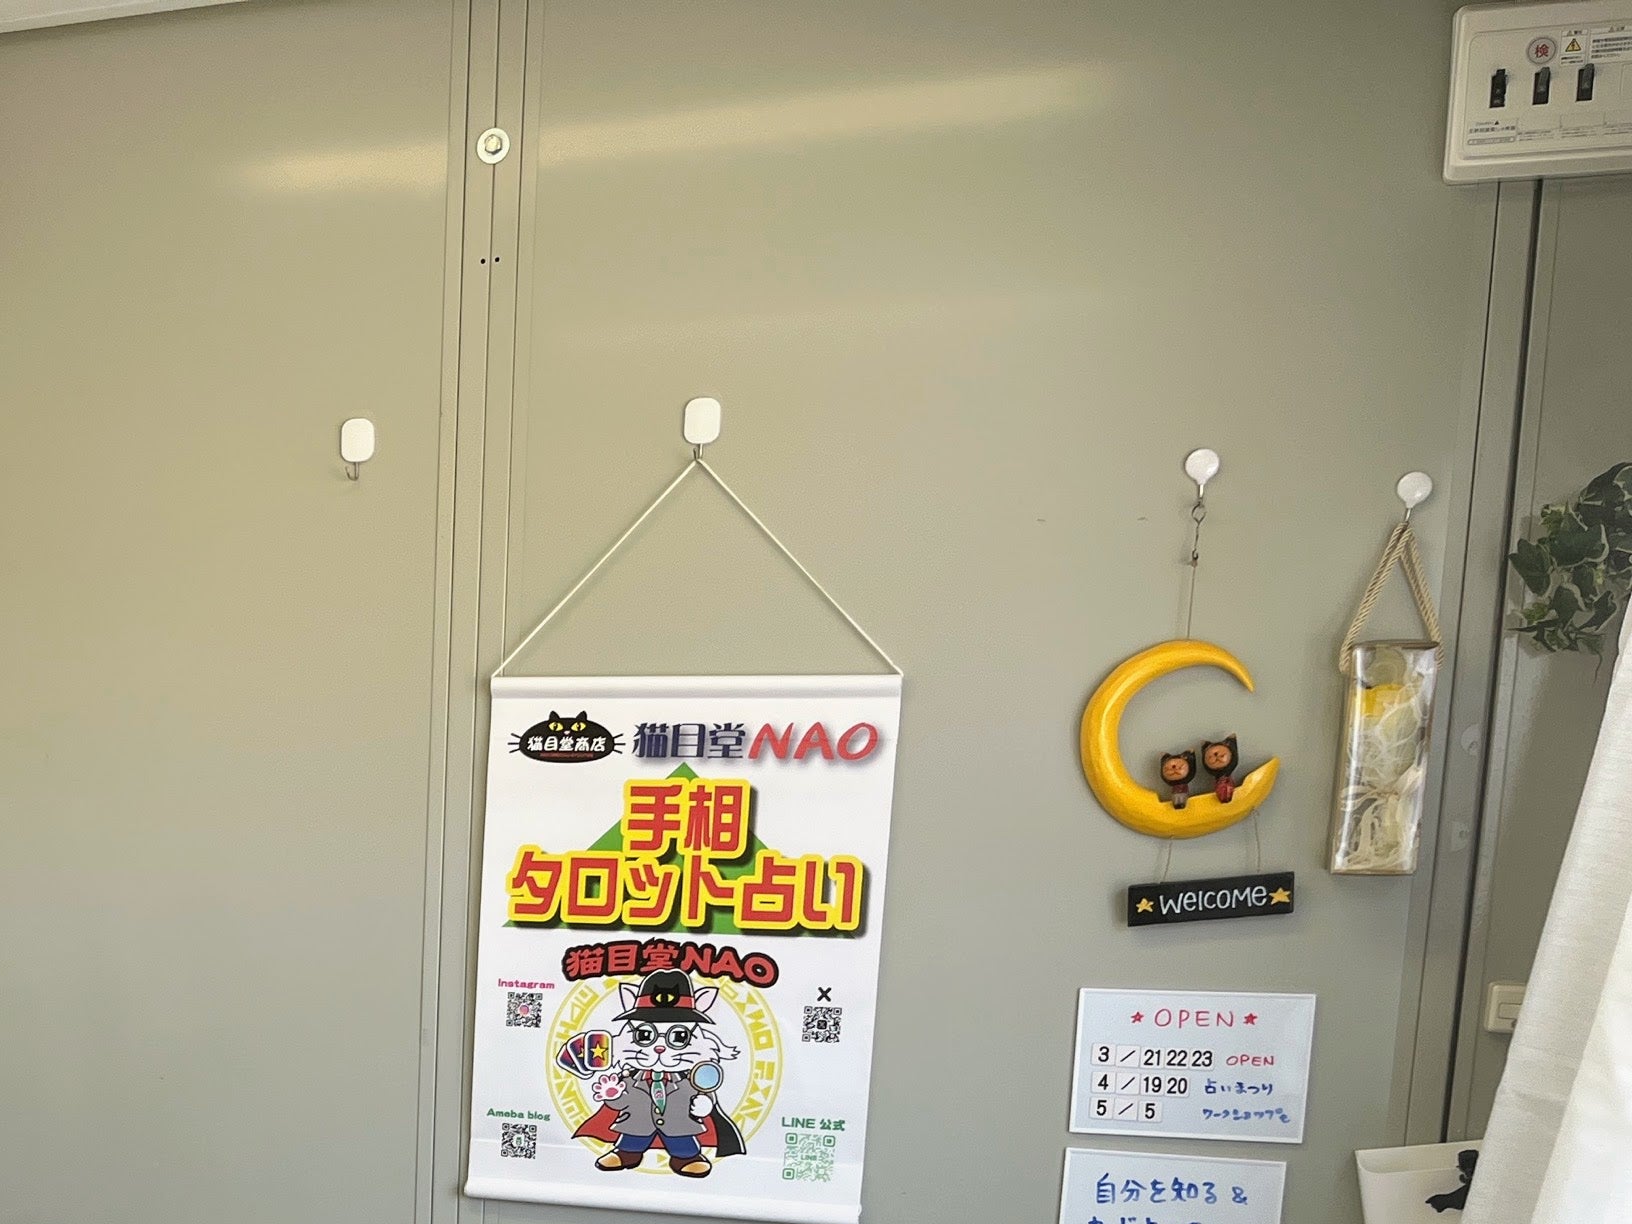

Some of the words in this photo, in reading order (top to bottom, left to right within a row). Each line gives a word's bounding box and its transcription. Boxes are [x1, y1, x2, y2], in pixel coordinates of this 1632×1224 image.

[527, 735, 606, 752] 猫目堂商店
[625, 781, 747, 854] 手相
[509, 848, 859, 926] タロット占い
[497, 978, 555, 990] Instagram
[1154, 1008, 1234, 1028] OPEN
[1226, 1053, 1275, 1067] OPEN
[1204, 1078, 1273, 1096] 占いまつり
[486, 1108, 525, 1119] Ameba
[527, 1110, 551, 1121] blog
[781, 1116, 816, 1129] LINE
[819, 1118, 846, 1132] 公式
[1096, 1172, 1218, 1204] 自分を知る
[1231, 1186, 1248, 1205] &
